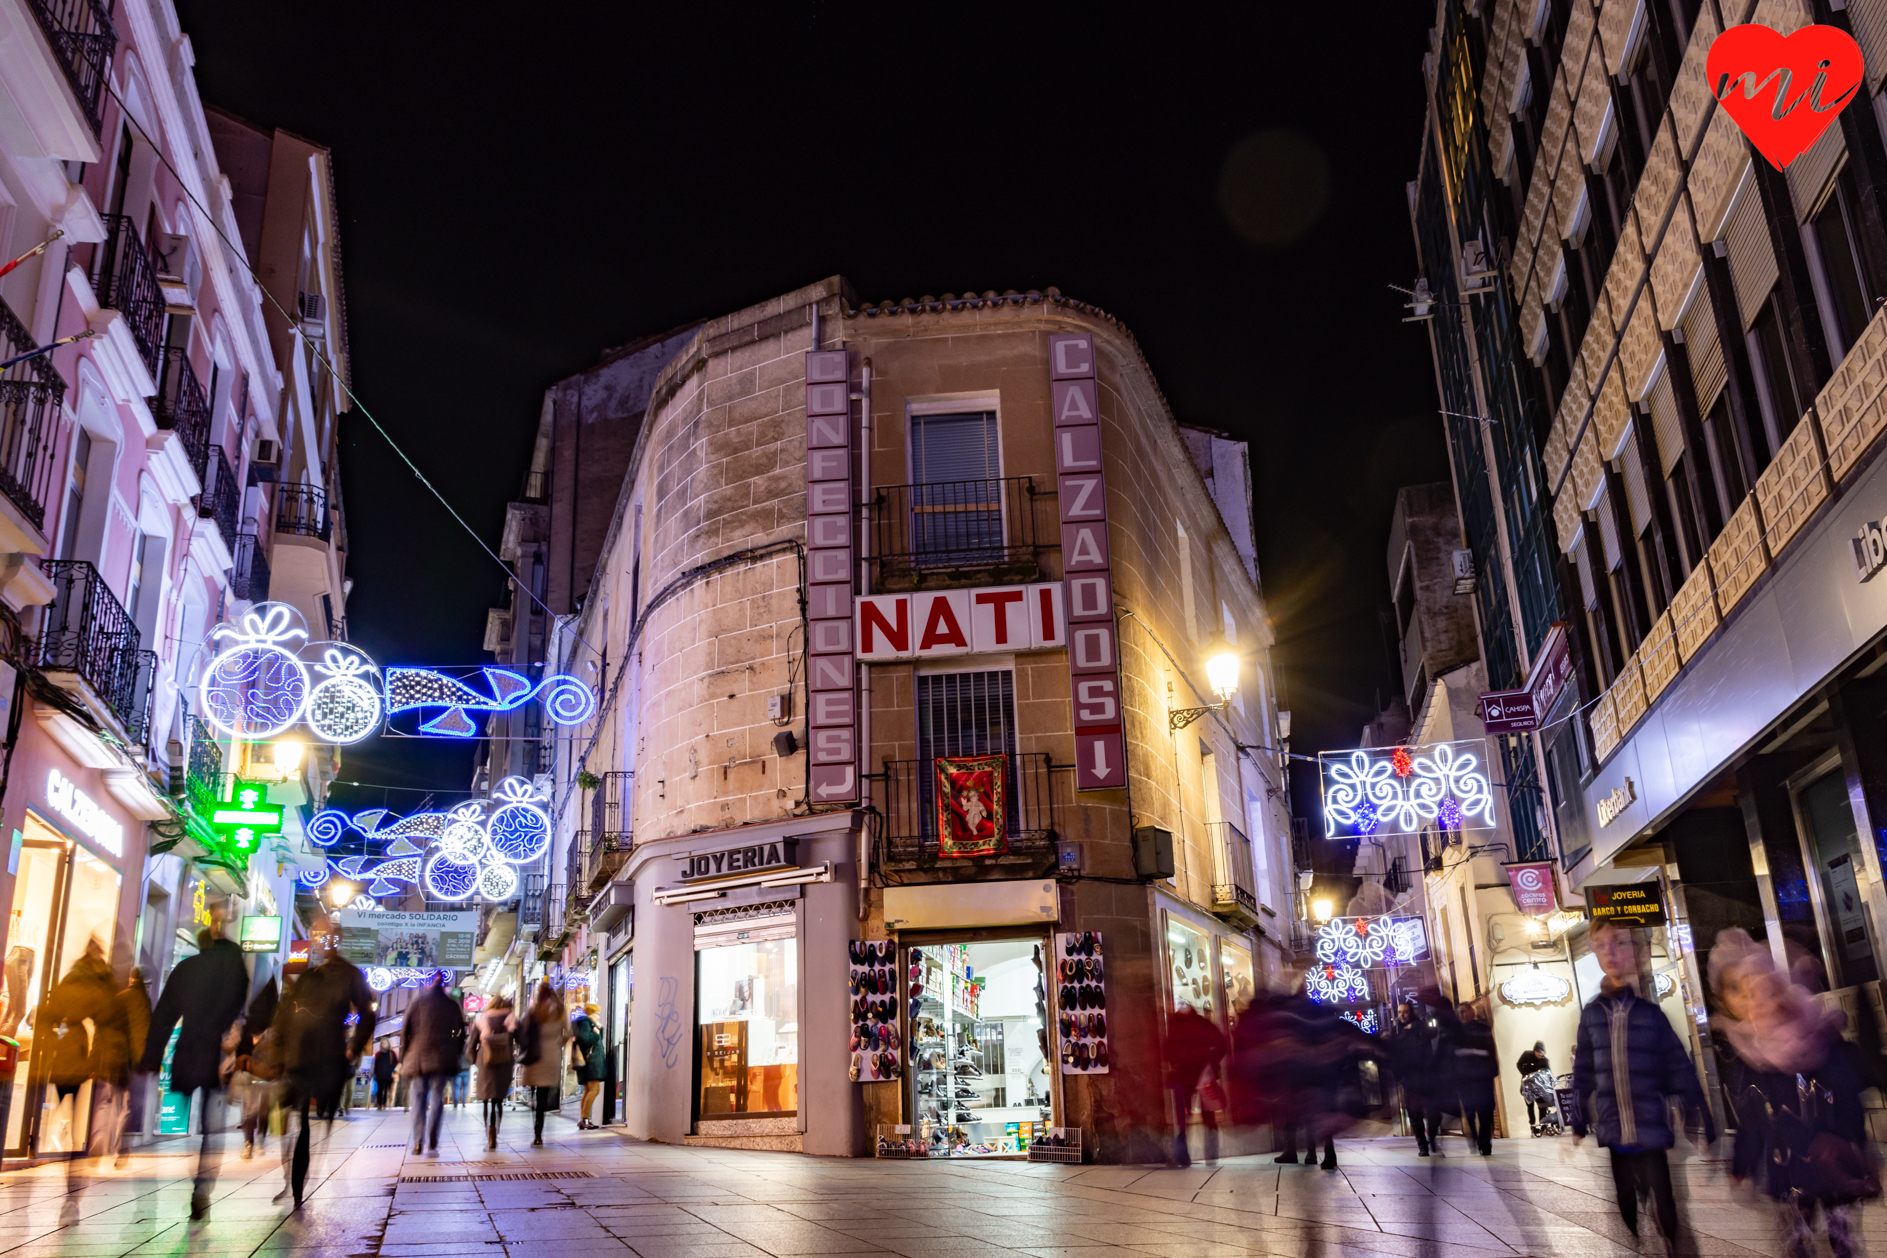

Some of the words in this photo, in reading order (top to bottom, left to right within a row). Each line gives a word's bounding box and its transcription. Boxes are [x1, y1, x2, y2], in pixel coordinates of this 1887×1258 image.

[1055, 339, 1116, 721] CALZADOS
[811, 353, 853, 762] CONFECCIONES
[859, 588, 1056, 654] NATI
[1510, 720, 1535, 728] SEGUROS
[681, 844, 781, 878] JOYERIA
[1612, 890, 1646, 901] JOYERIA
[357, 911, 367, 919] VI
[368, 912, 407, 920] mercado
[408, 913, 459, 922] SOLIDARIO
[1592, 906, 1615, 917] BARCO
[1617, 906, 1622, 914] Y
[1623, 903, 1660, 915] CORBACHO
